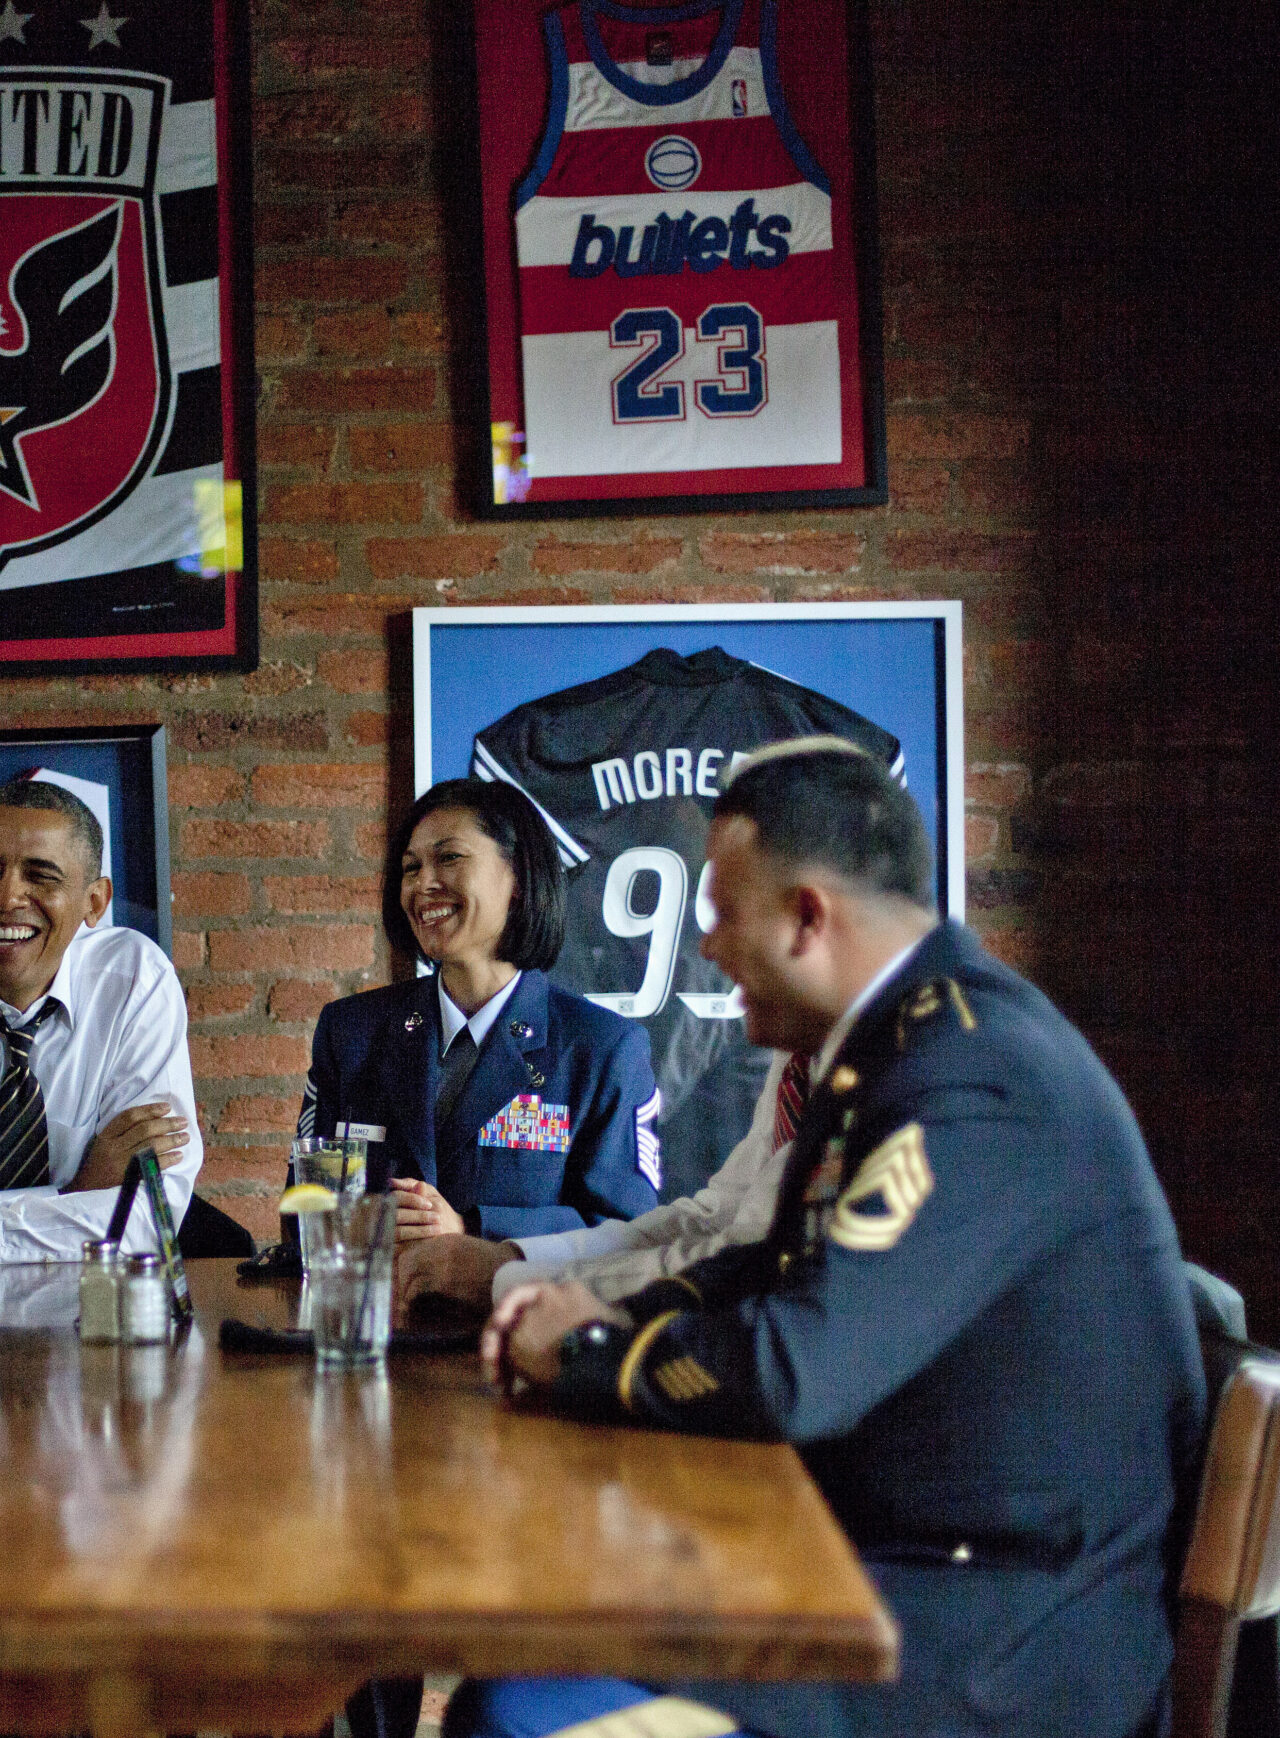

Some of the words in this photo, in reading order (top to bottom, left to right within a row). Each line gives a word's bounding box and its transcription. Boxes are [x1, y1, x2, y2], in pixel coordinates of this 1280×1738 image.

[569, 198, 792, 278] bullets
[609, 302, 769, 425] 23
[591, 748, 751, 811] MORE
